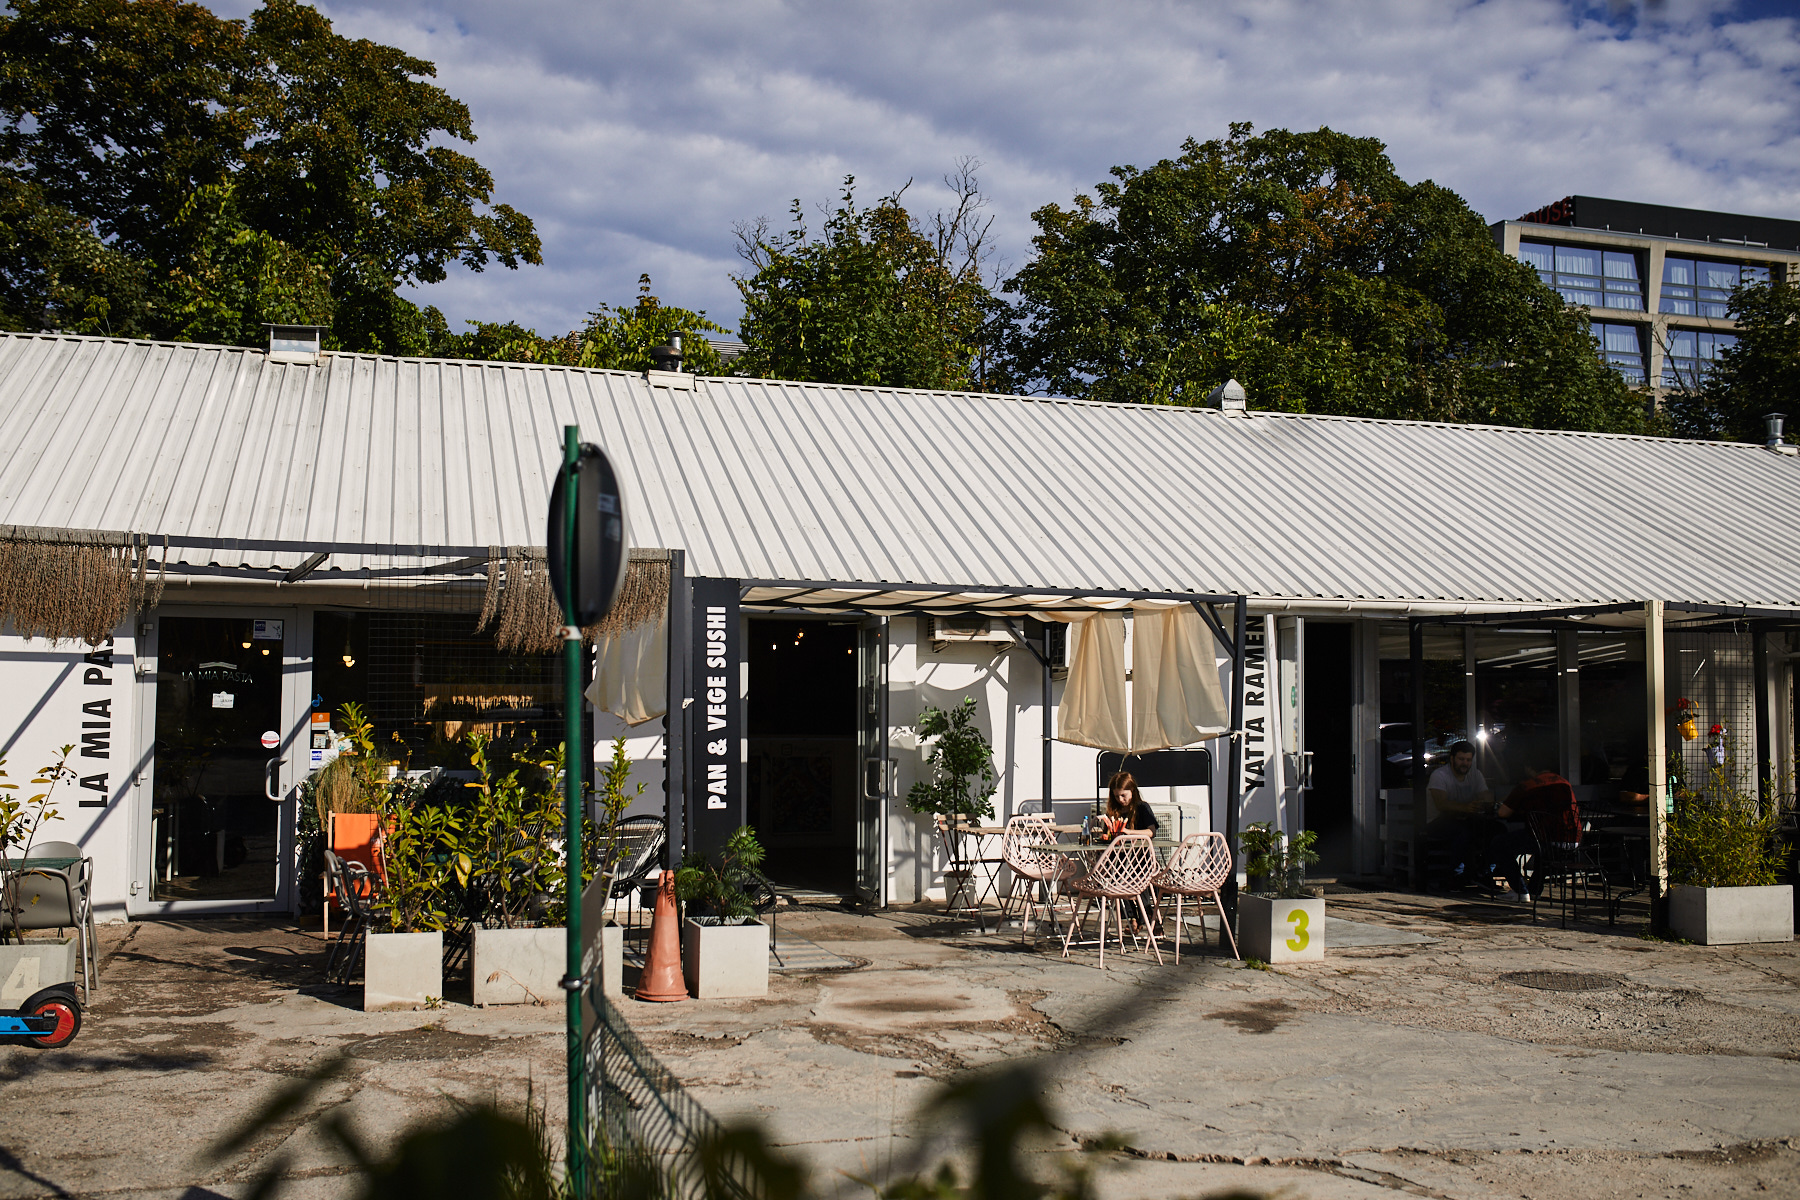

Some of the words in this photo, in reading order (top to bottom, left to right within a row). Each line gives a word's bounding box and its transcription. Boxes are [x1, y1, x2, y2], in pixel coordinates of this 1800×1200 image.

[1519, 195, 1572, 225] OUSE
[706, 606, 727, 669] SUSHI
[181, 671, 196, 682] LA
[198, 670, 219, 681] MIA
[222, 671, 254, 684] PASTA
[1244, 615, 1265, 706] RAMEN
[706, 676, 727, 732] VEGE
[81, 698, 112, 760] MIA
[707, 738, 728, 756] &
[1244, 716, 1265, 793] YATTA
[79, 772, 109, 808] LA
[707, 764, 727, 810] PAN
[1286, 908, 1310, 953] 3
[1, 956, 41, 1001] 4
